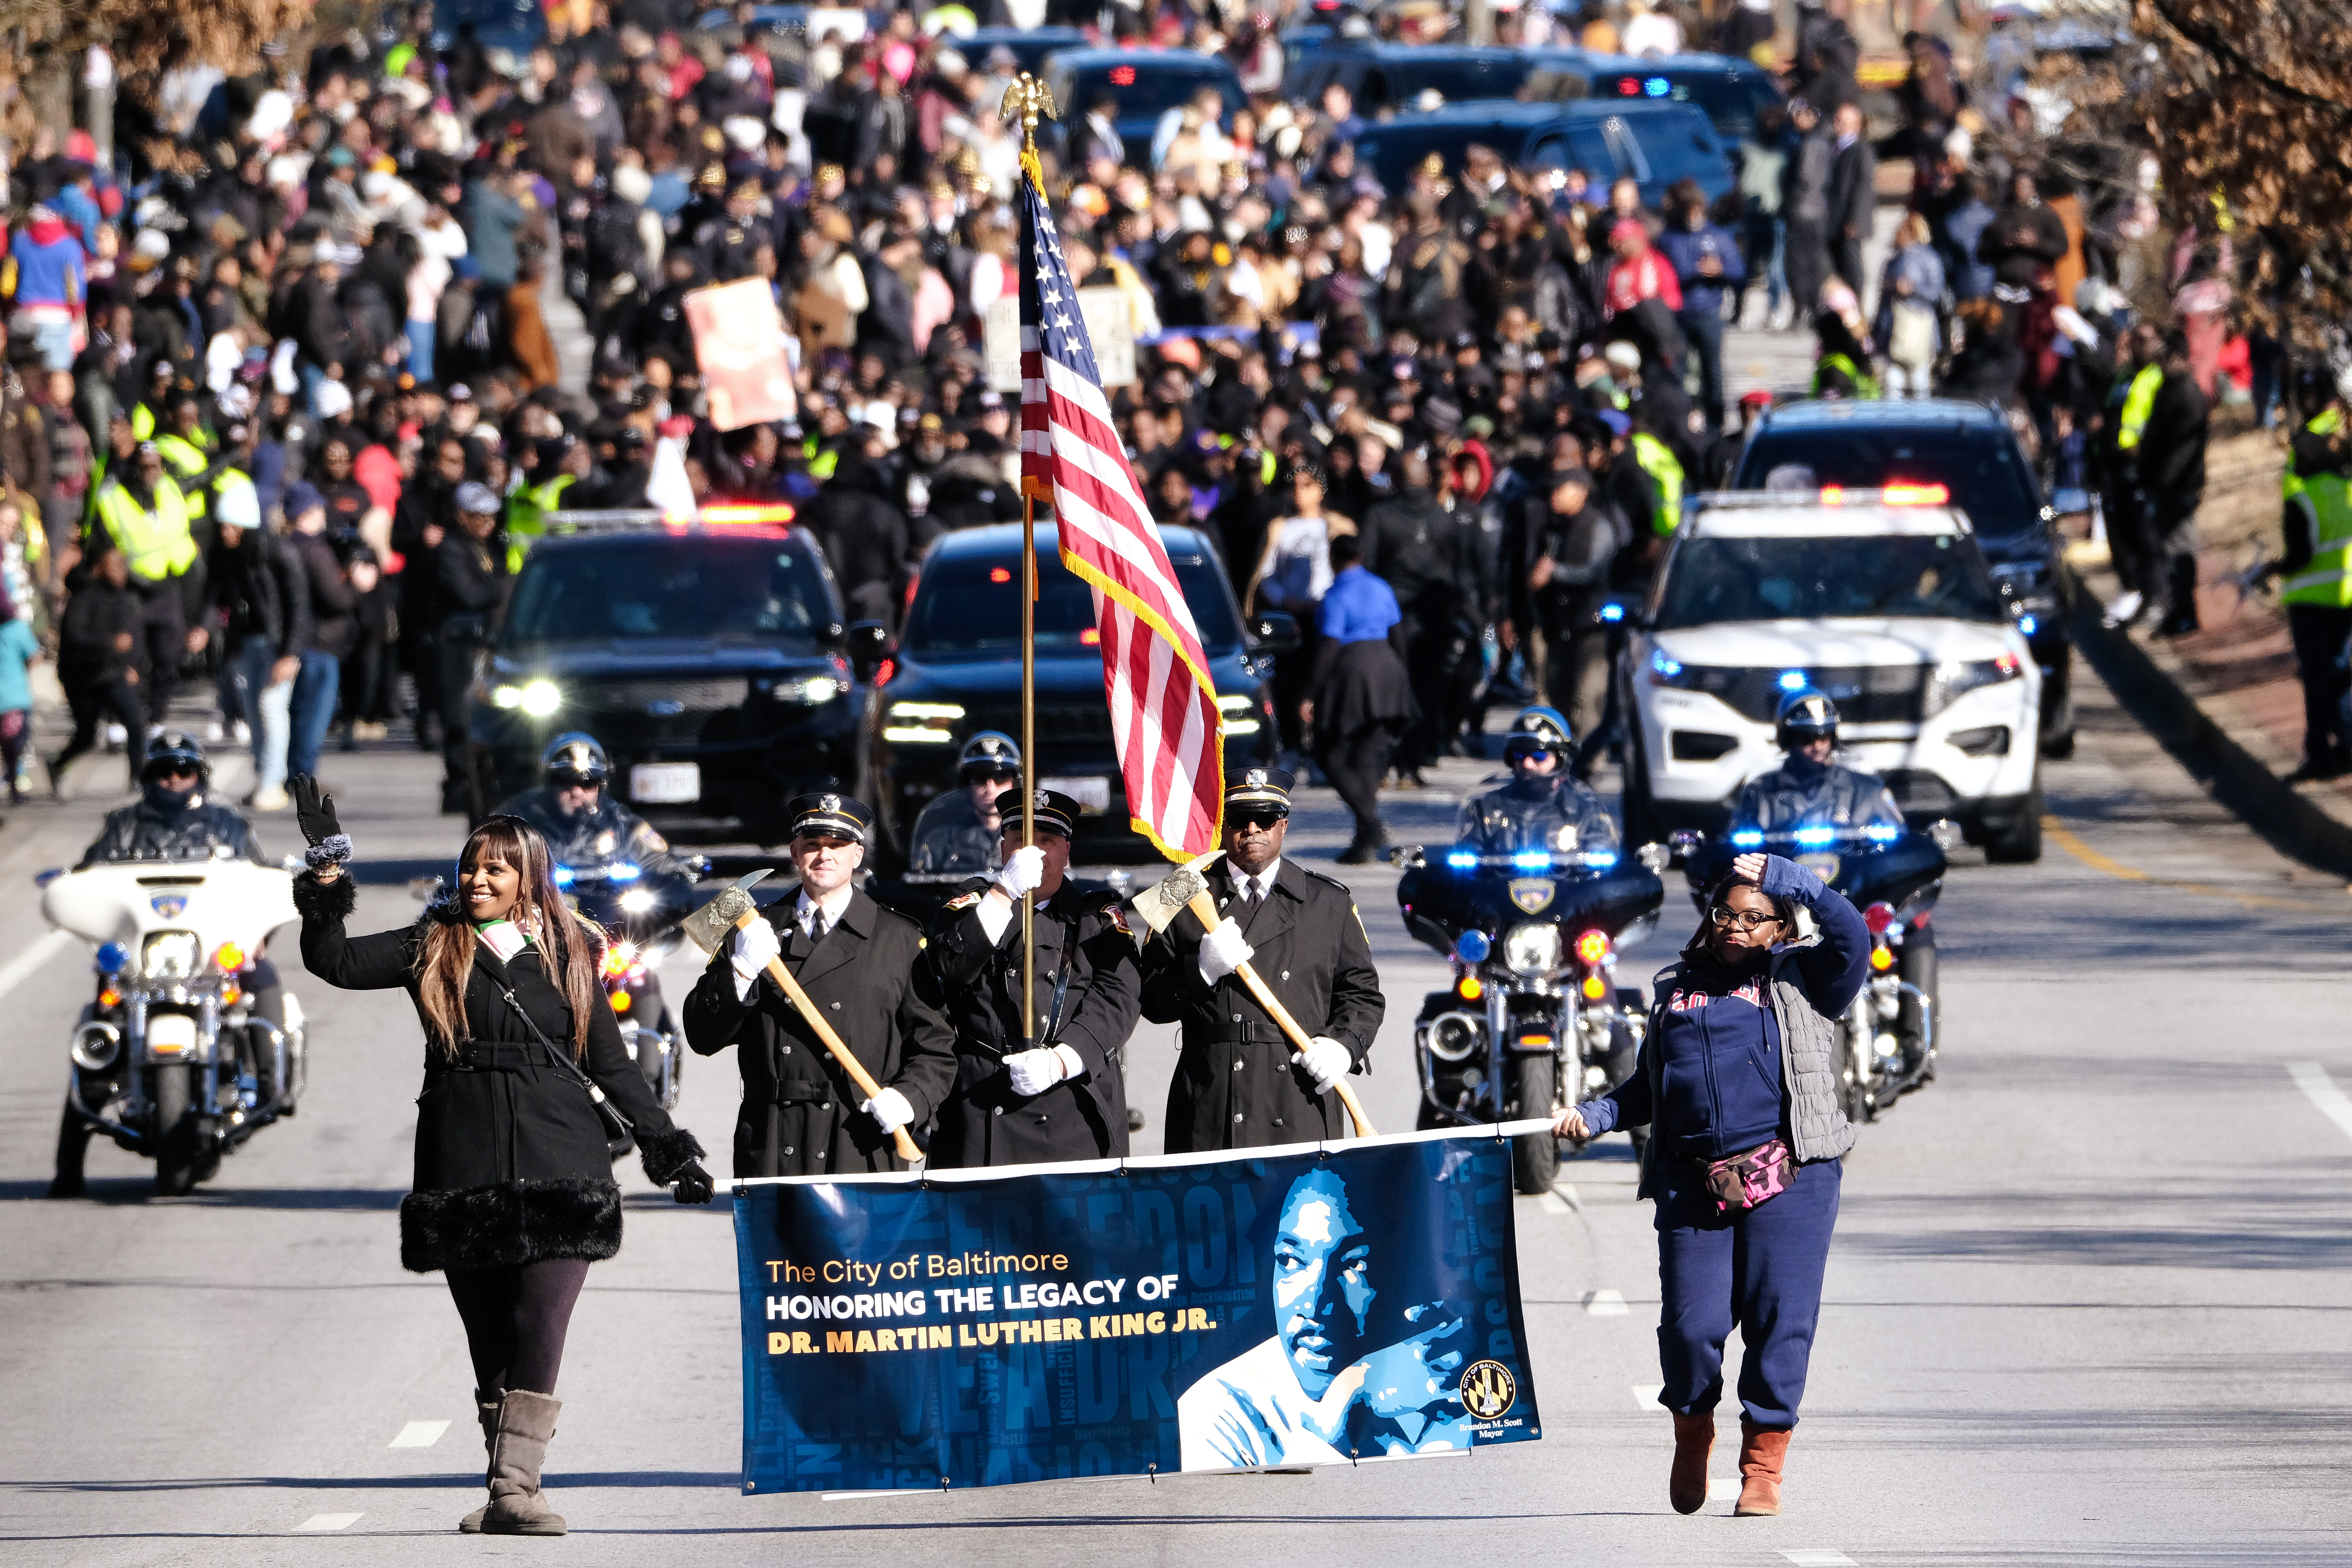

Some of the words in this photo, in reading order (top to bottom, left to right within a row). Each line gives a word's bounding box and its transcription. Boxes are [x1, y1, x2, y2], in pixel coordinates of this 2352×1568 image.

[766, 1260, 815, 1283] The
[823, 1259, 882, 1287] City
[889, 1254, 919, 1279] of
[928, 1251, 1068, 1277] Baltimore
[766, 1290, 926, 1320] HONORING
[934, 1286, 994, 1313] THE
[1003, 1278, 1126, 1309] LEGACY
[1137, 1274, 1178, 1300] OF
[768, 1331, 820, 1354] DR.
[826, 1325, 952, 1353] MARTIN
[959, 1318, 1084, 1347] LUTHER
[1090, 1311, 1166, 1338] KING
[1172, 1308, 1217, 1332] JR.
[1463, 1373, 1472, 1389] CITY
[1470, 1366, 1478, 1375] OF
[1479, 1363, 1512, 1386] BALTIMORE
[1459, 1422, 1491, 1432] Brandon
[1492, 1420, 1503, 1428] M.
[1504, 1418, 1522, 1427] Scott
[1479, 1430, 1504, 1439] Mayor
